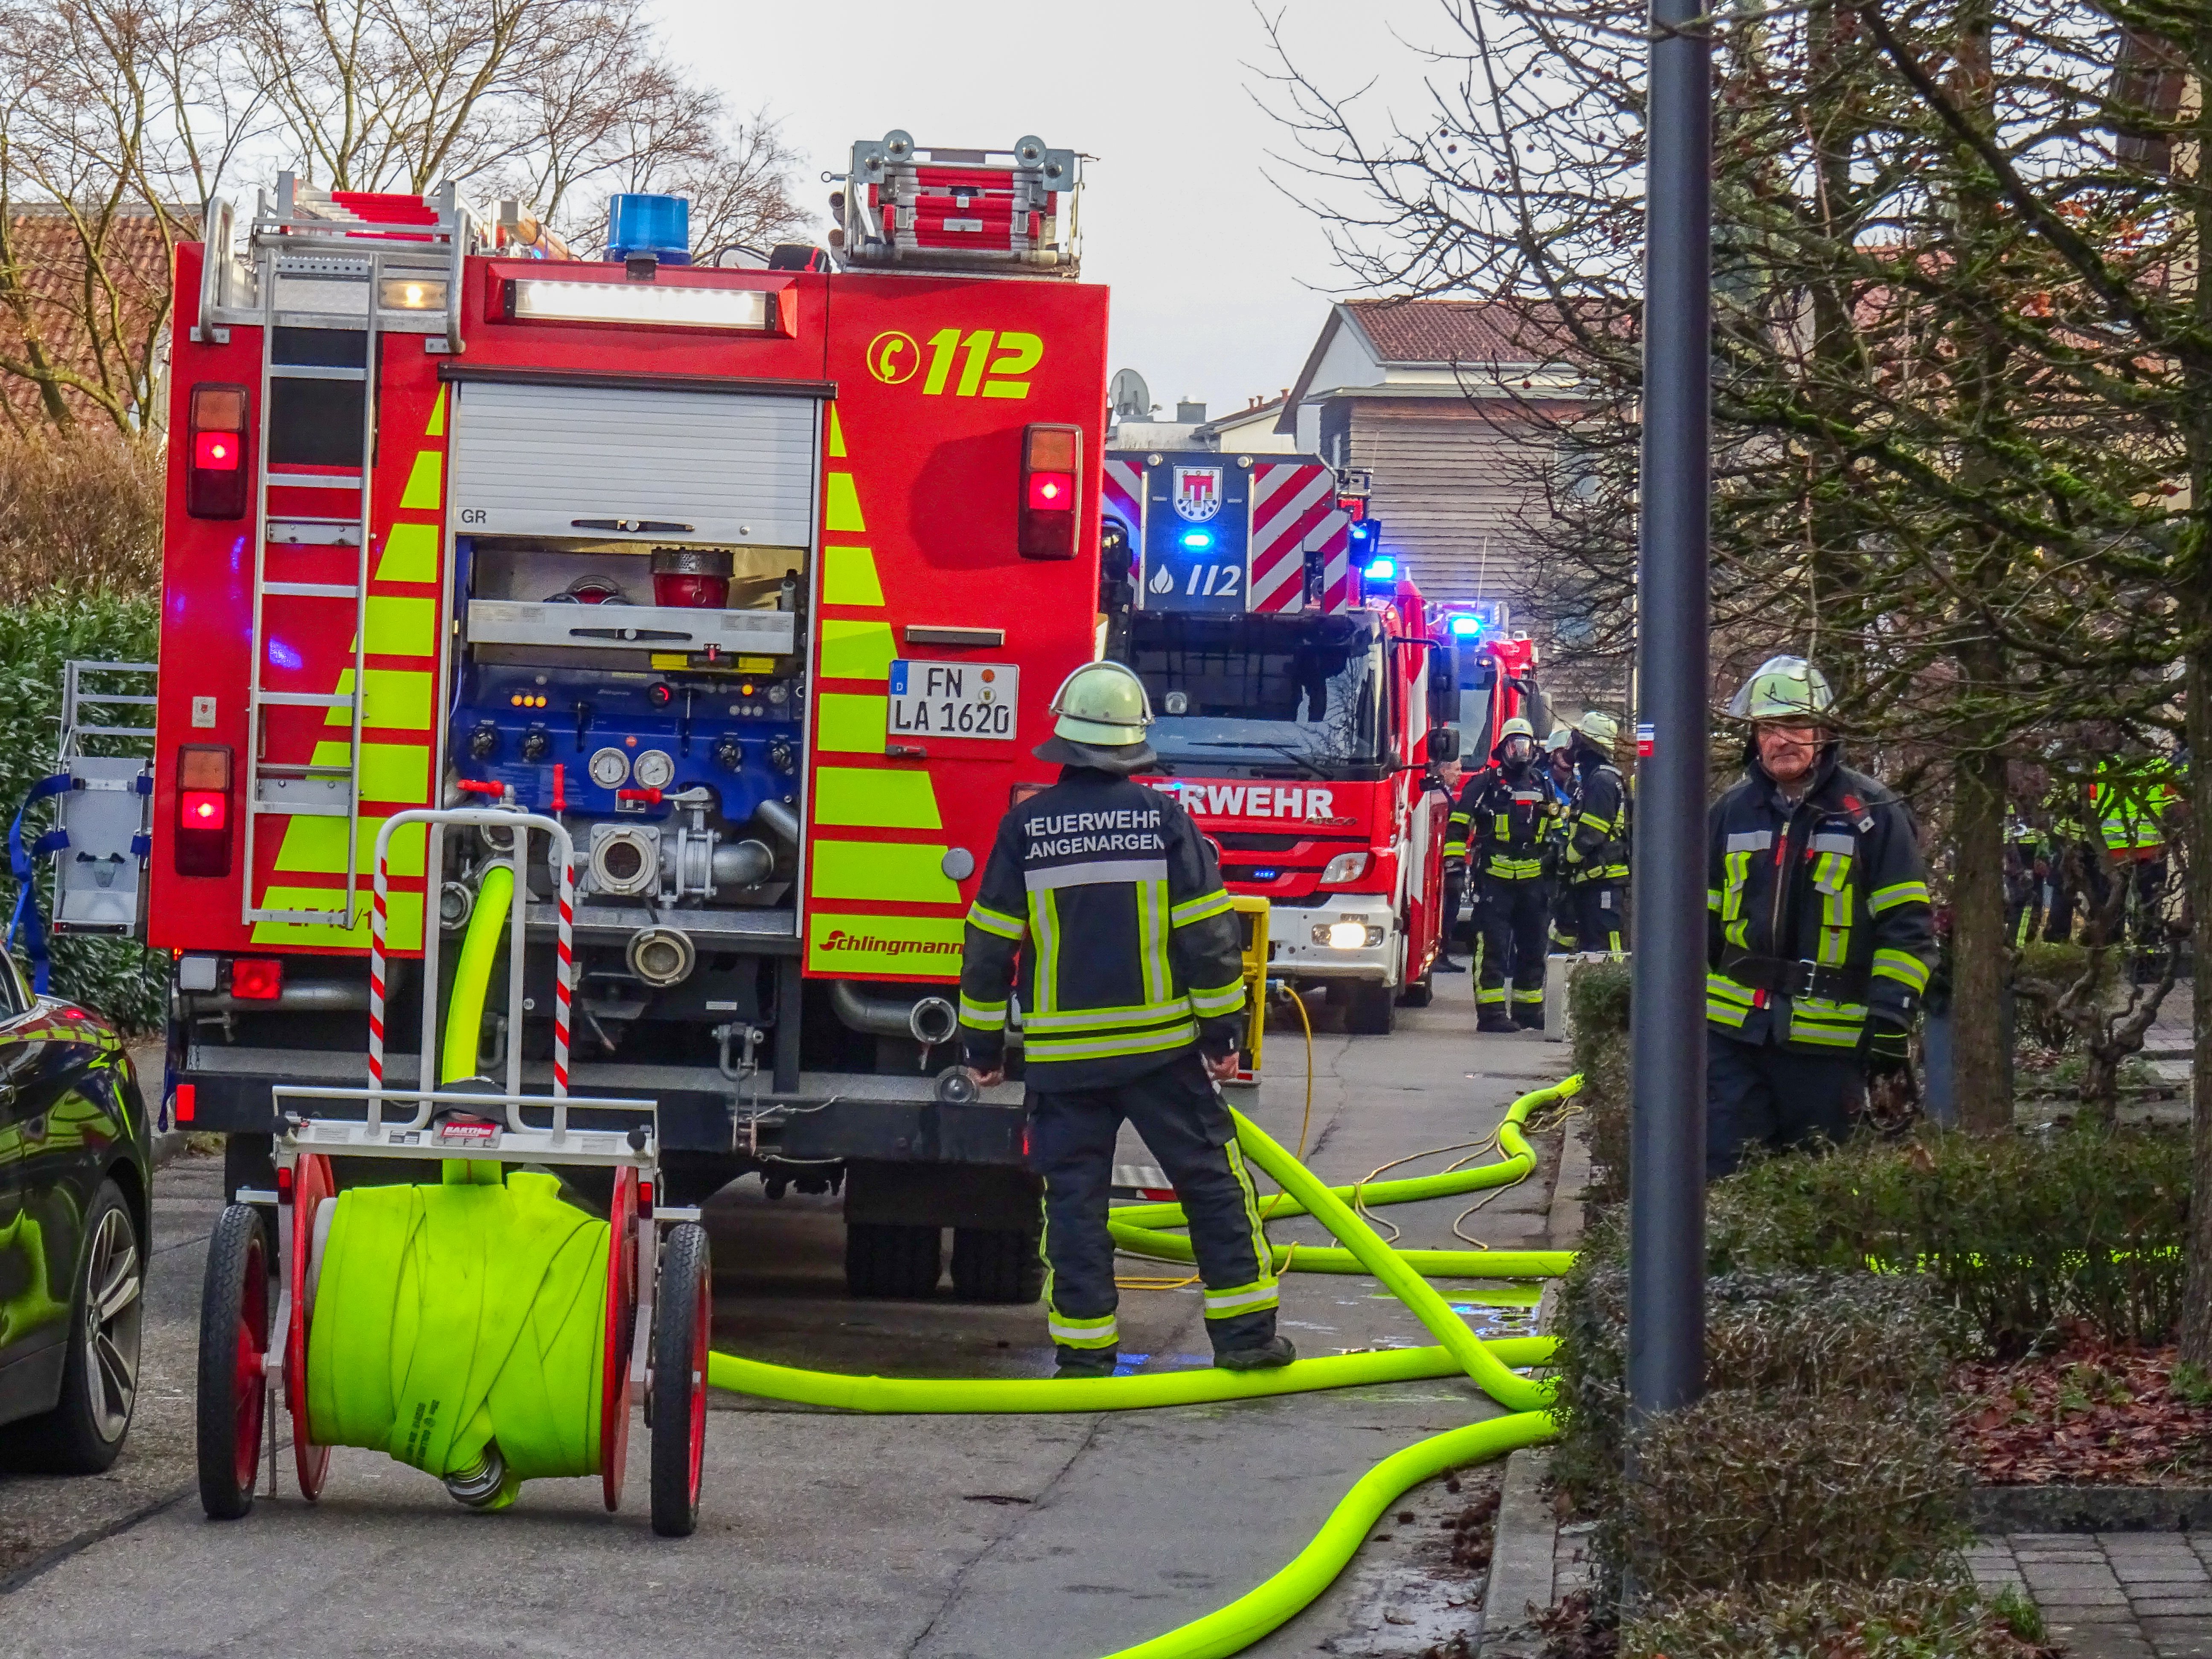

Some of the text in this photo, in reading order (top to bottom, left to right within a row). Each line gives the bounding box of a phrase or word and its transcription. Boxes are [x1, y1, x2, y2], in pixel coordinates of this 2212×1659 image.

[923, 328, 1045, 399] 112
[462, 509, 486, 524] GR
[1186, 565, 1241, 596] 112
[896, 682, 903, 691] D
[927, 667, 963, 698] FN
[895, 700, 1009, 734] LA 1620
[1025, 833, 1165, 860] ANGENARGEN
[819, 930, 964, 955] Schlingmann
